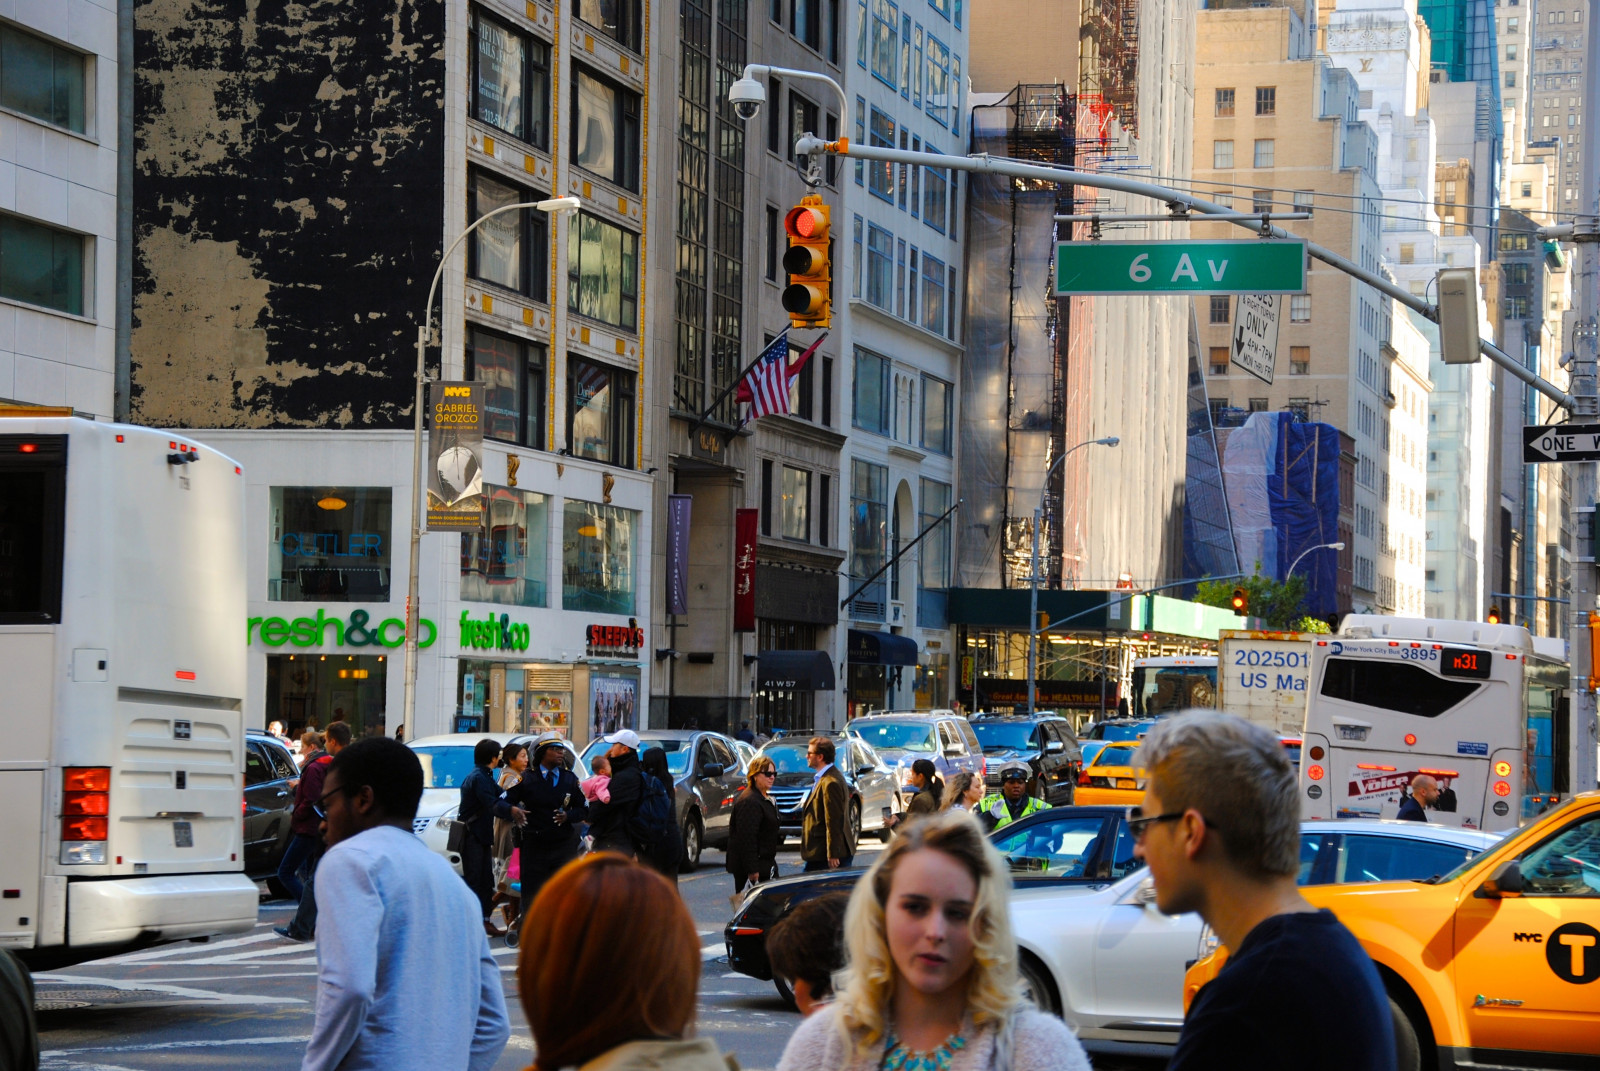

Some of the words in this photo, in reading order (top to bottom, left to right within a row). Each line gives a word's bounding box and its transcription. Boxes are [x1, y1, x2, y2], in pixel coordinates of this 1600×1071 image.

[1128, 253, 1152, 283] 6
[1170, 253, 1229, 282] Av
[1260, 305, 1275, 322] TURNS
[1246, 311, 1268, 340] ONLY
[1243, 352, 1254, 369] MON
[1254, 359, 1264, 375] THRU
[1264, 365, 1272, 379] FRI
[444, 386, 471, 397] NYC
[435, 403, 478, 413] GABRIEL
[435, 413, 479, 424] OROZCO
[1542, 436, 1576, 451] ONE
[280, 532, 382, 557] CUTLER
[247, 608, 437, 648] resh&co
[459, 609, 531, 651] fresh&co
[1234, 649, 1311, 669] 202501
[1374, 647, 1386, 655] City
[1400, 648, 1438, 661] 3895
[785, 680, 796, 688] 57
[1241, 672, 1268, 689] US
[1276, 674, 1307, 691] Ma
[1051, 693, 1082, 702] HEALTH
[1083, 694, 1100, 702] BAR
[1513, 932, 1543, 943] NYC
[1558, 933, 1597, 977] T
